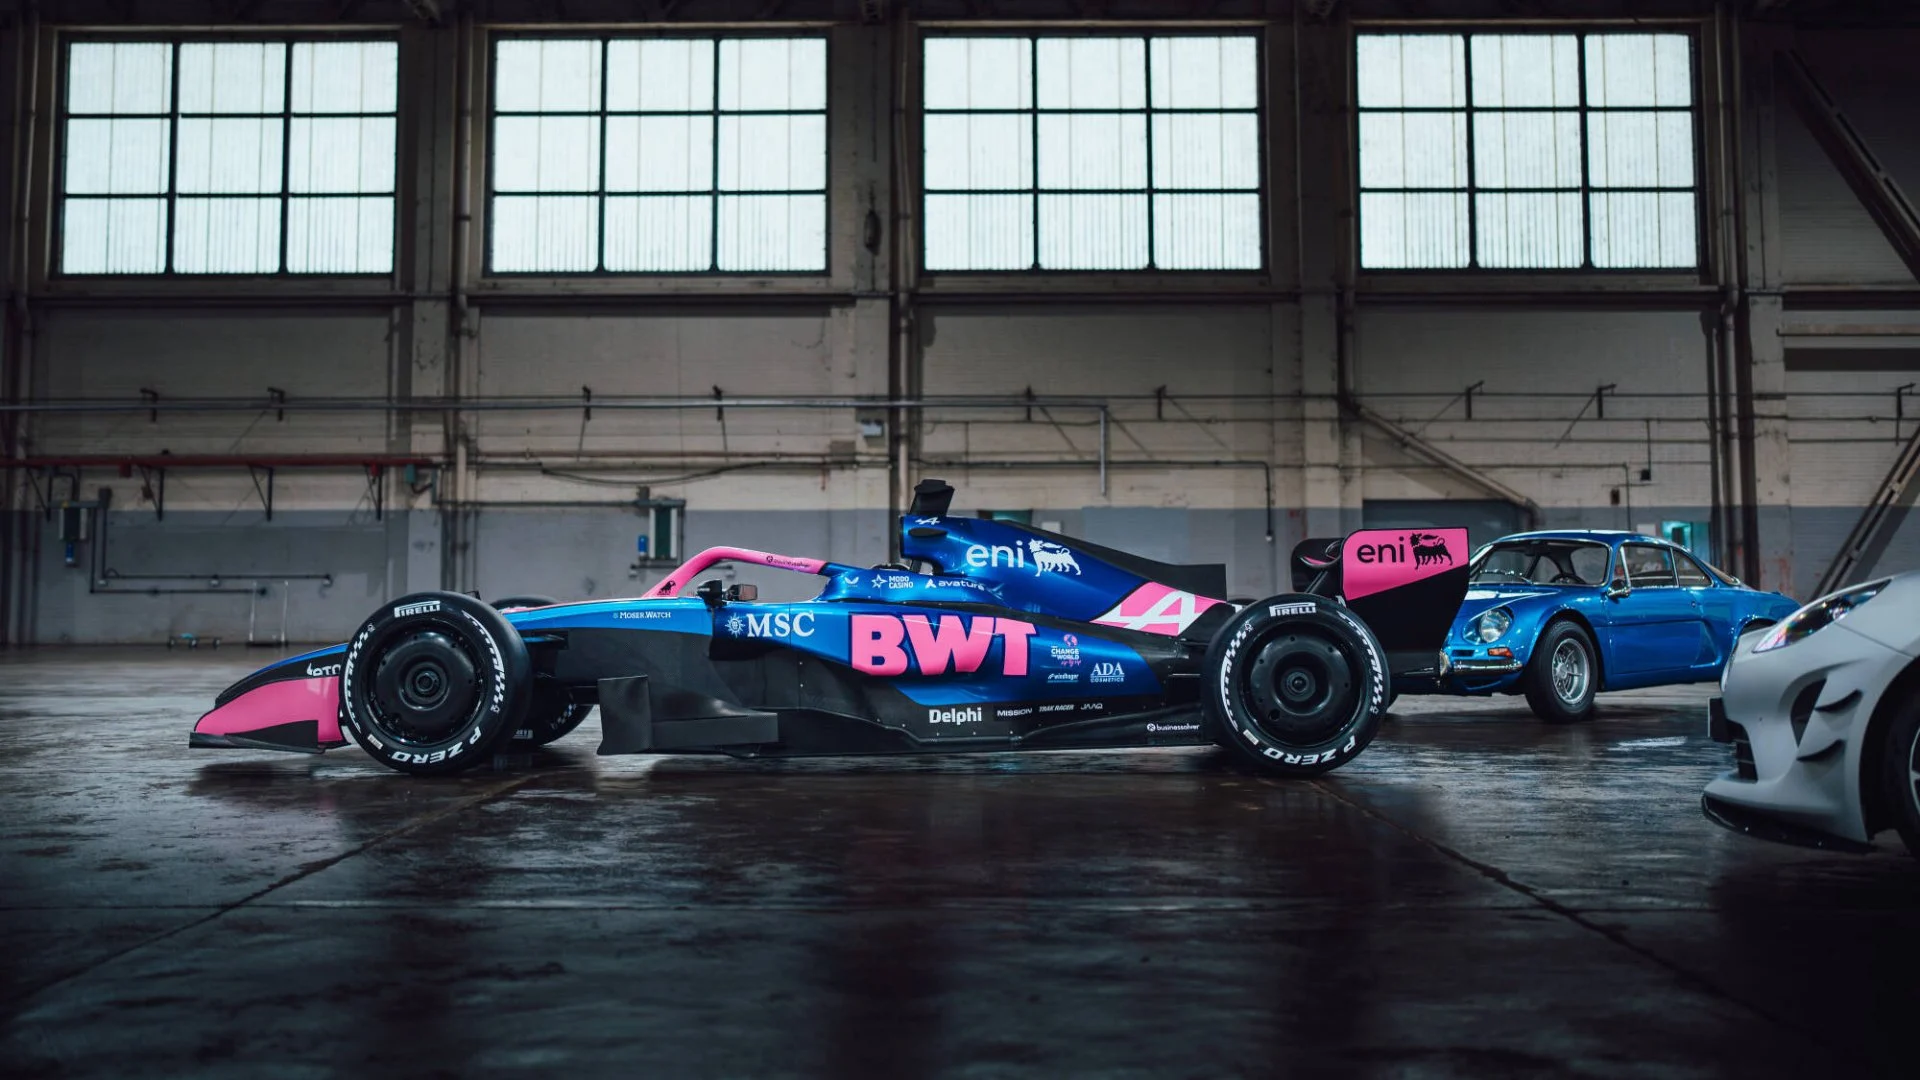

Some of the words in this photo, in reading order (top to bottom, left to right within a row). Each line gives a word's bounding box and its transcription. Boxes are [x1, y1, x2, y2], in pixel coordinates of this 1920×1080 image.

[966, 540, 1024, 568] eni
[1357, 536, 1405, 563] eni
[938, 580, 985, 591] avature
[394, 600, 441, 618] PIRELLI
[1269, 602, 1317, 617] PIRELLI
[746, 610, 815, 637] MSC
[851, 614, 1037, 676] BWT
[1091, 661, 1125, 676] ADA
[1090, 676, 1124, 684] COSMETICS
[929, 706, 982, 725] Delphi
[997, 707, 1033, 717] MISSION
[469, 726, 482, 745] P
[1343, 735, 1356, 753] P
[391, 741, 464, 764] ZERO
[1263, 747, 1337, 765] ZERO
